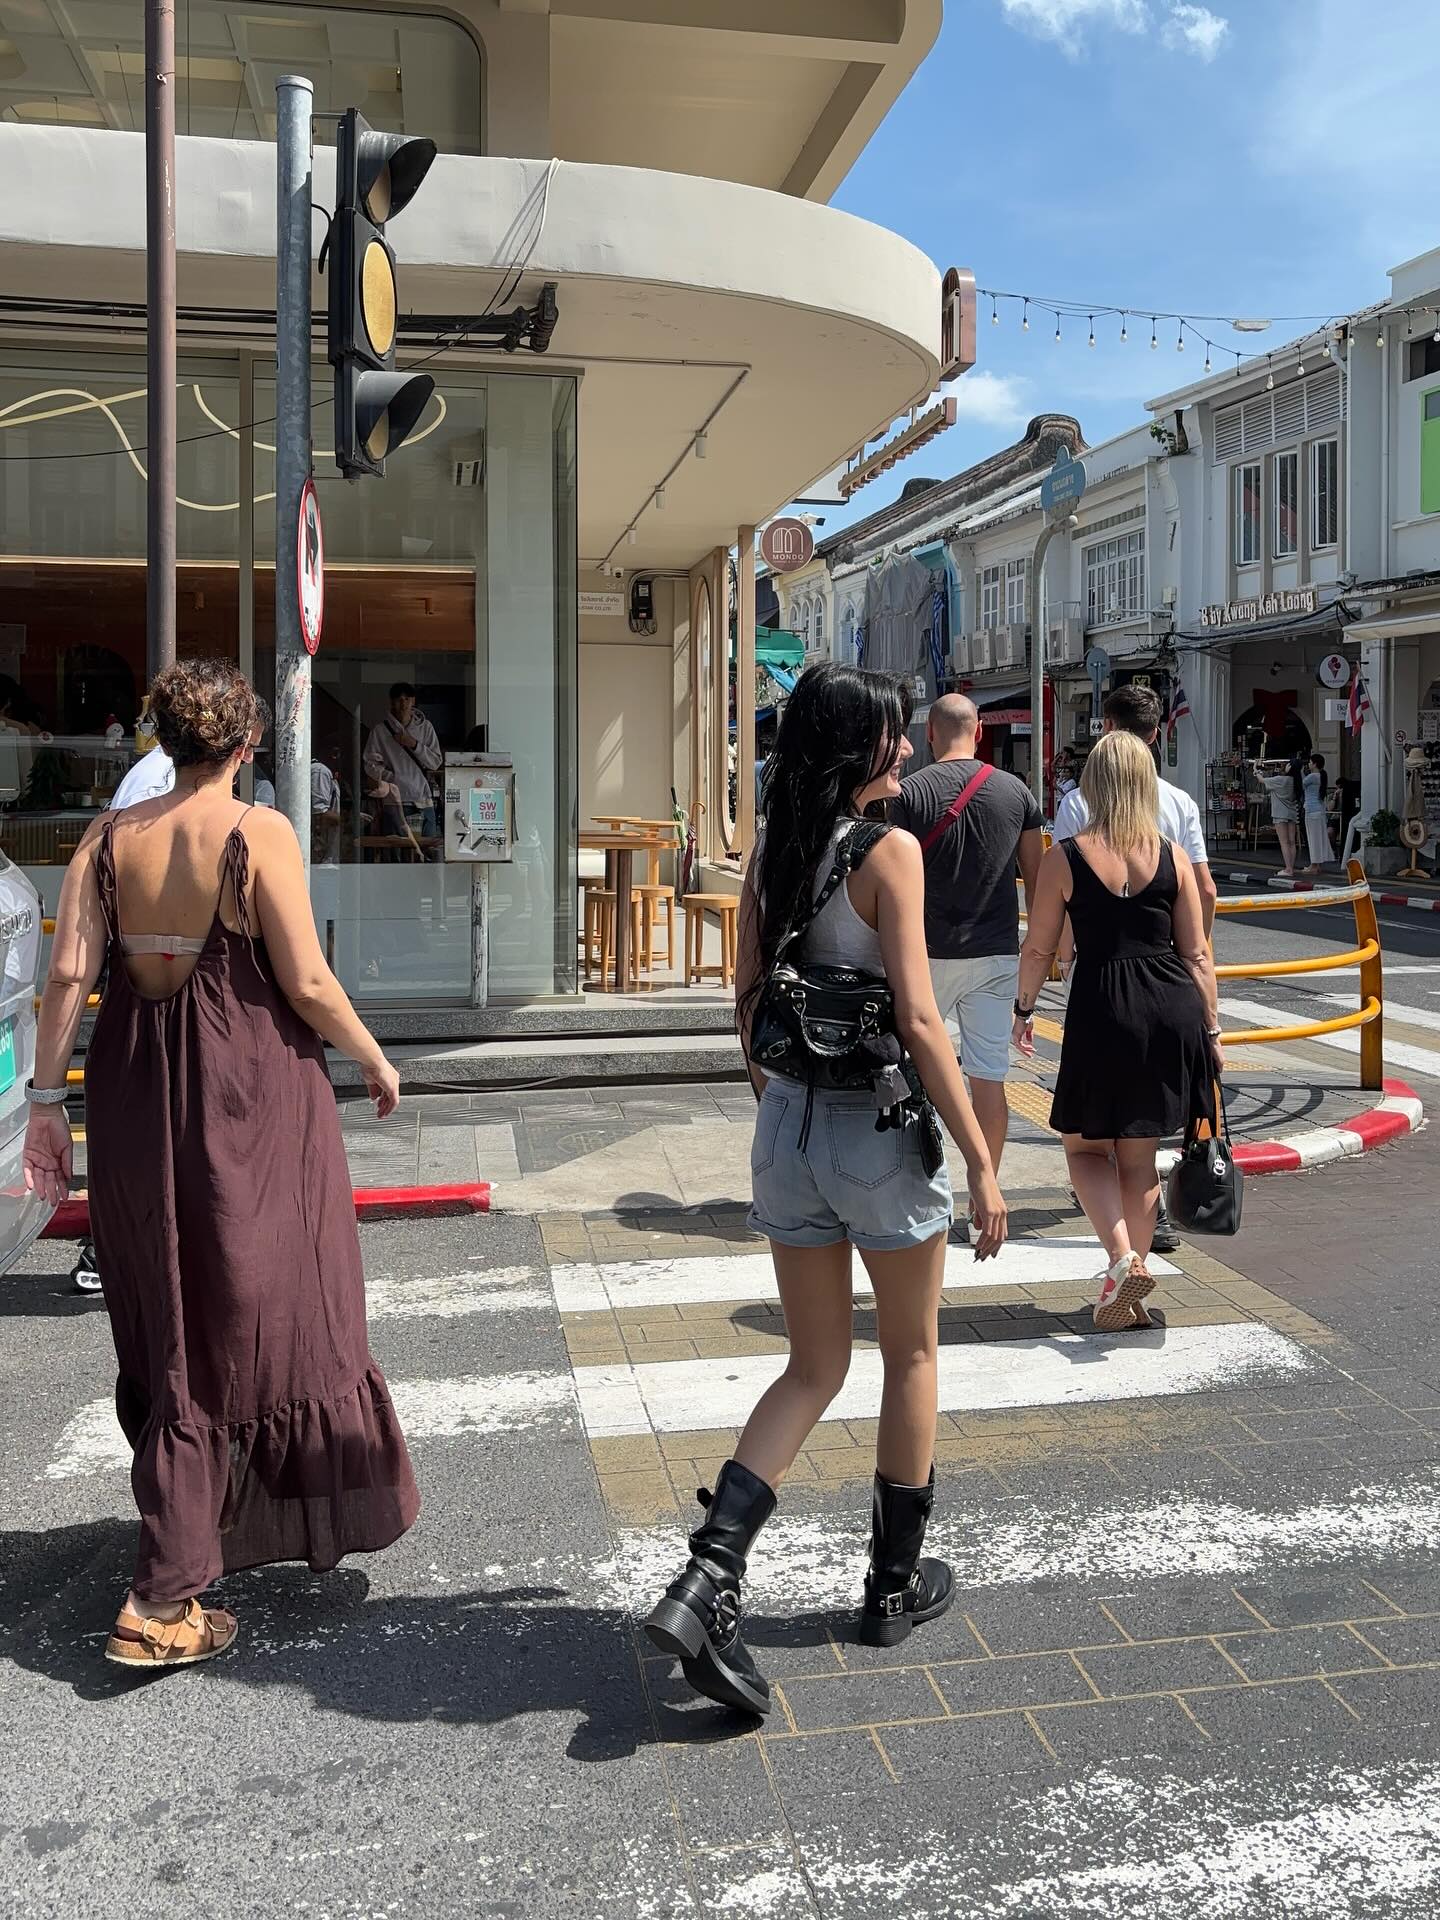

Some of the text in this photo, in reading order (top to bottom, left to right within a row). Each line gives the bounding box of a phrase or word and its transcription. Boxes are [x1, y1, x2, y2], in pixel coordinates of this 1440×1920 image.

[1210, 605, 1222, 627] by
[479, 802, 497, 811] SW
[479, 811, 497, 820] 169
